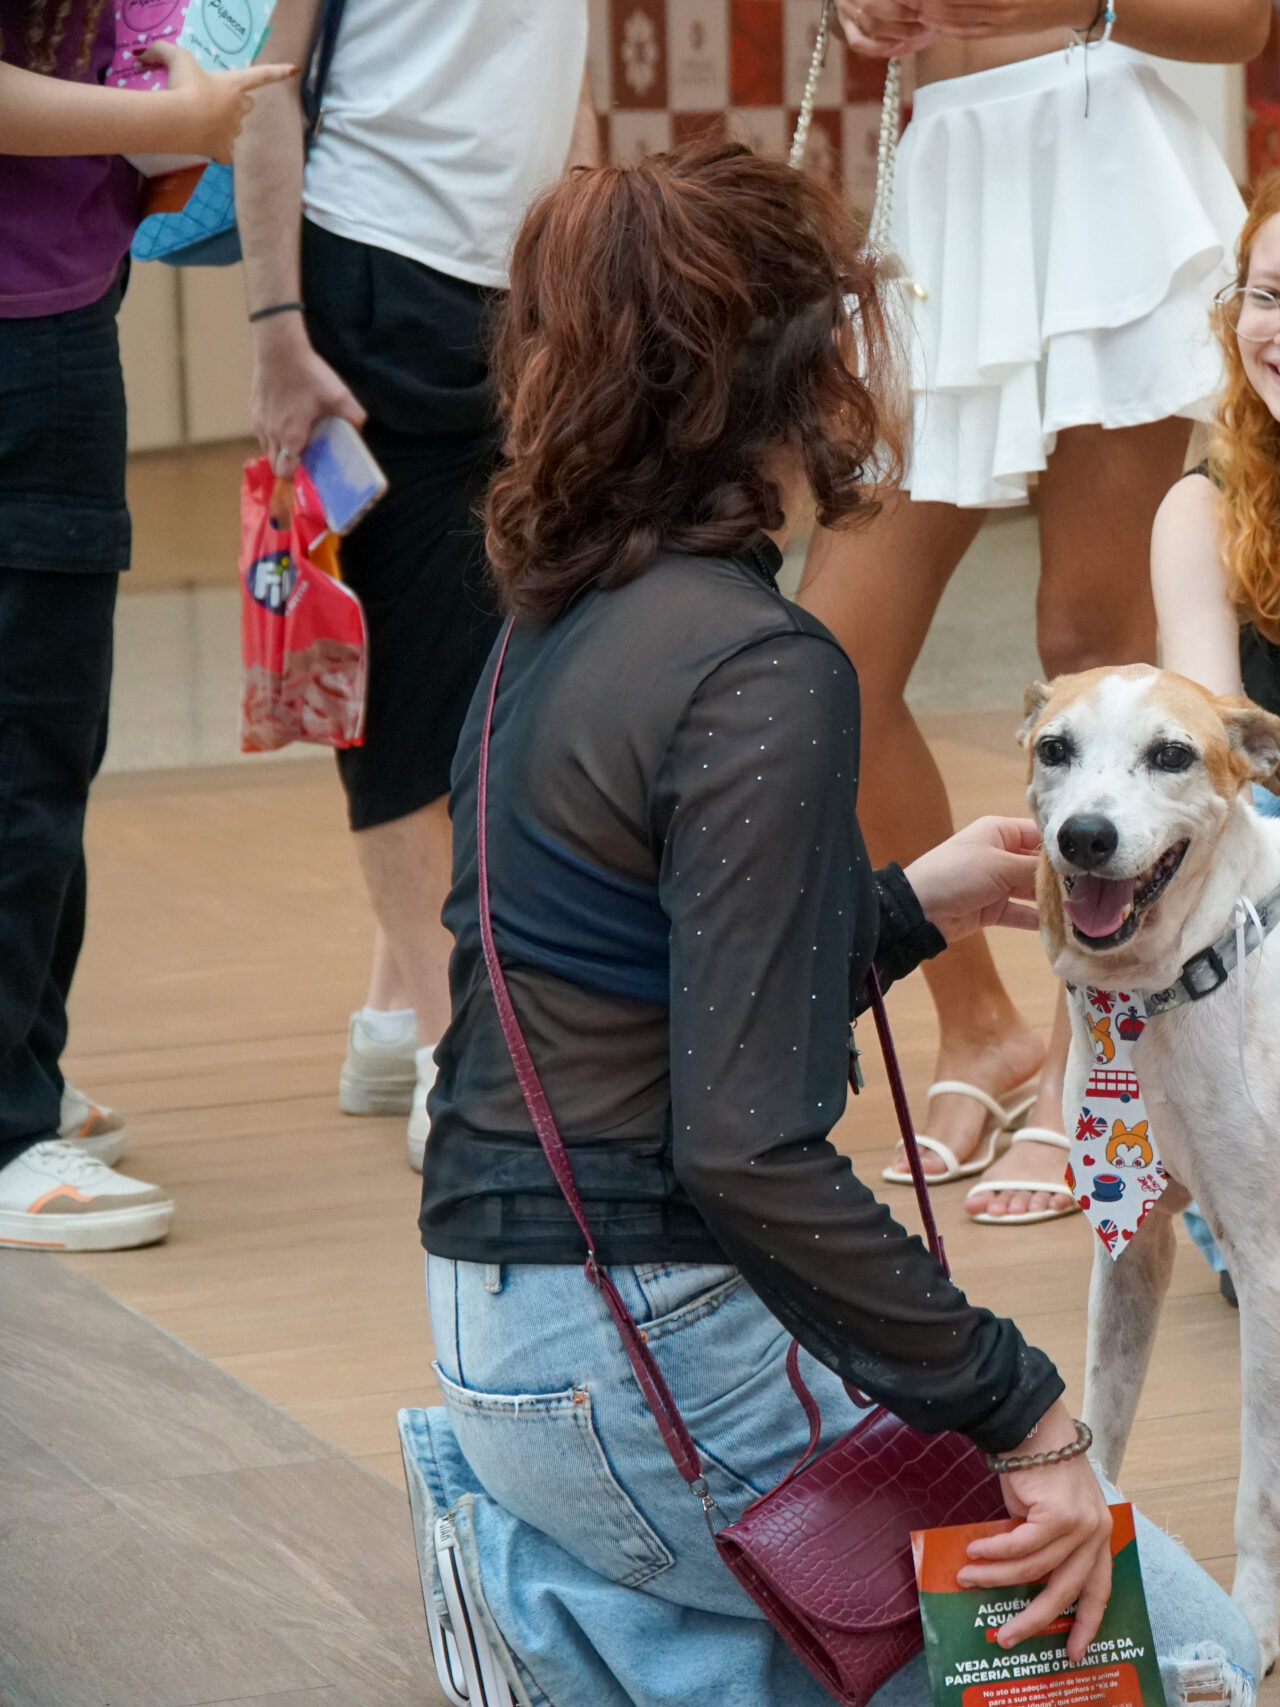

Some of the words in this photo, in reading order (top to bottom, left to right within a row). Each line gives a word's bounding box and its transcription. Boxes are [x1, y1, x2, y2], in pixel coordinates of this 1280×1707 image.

[978, 1598, 1031, 1615] ALGUÉM
[974, 1617, 985, 1628] A
[987, 1612, 1020, 1627] QUA
[955, 1659, 989, 1673] VEJA
[992, 1653, 1036, 1668] AGORA
[1039, 1650, 1053, 1661] OS
[1116, 1637, 1134, 1649] DA
[944, 1669, 1010, 1687] PARCERIA
[1013, 1662, 1051, 1677] ENTRE
[1052, 1661, 1060, 1671] O
[1101, 1653, 1108, 1663] E
[1110, 1652, 1119, 1662] A
[1121, 1647, 1145, 1659] MVV
[983, 1690, 994, 1698] No
[996, 1689, 1009, 1697] ato
[1010, 1686, 1020, 1695] da
[1097, 1670, 1120, 1680] animal
[988, 1699, 1006, 1707] para
[1013, 1696, 1027, 1704] sua
